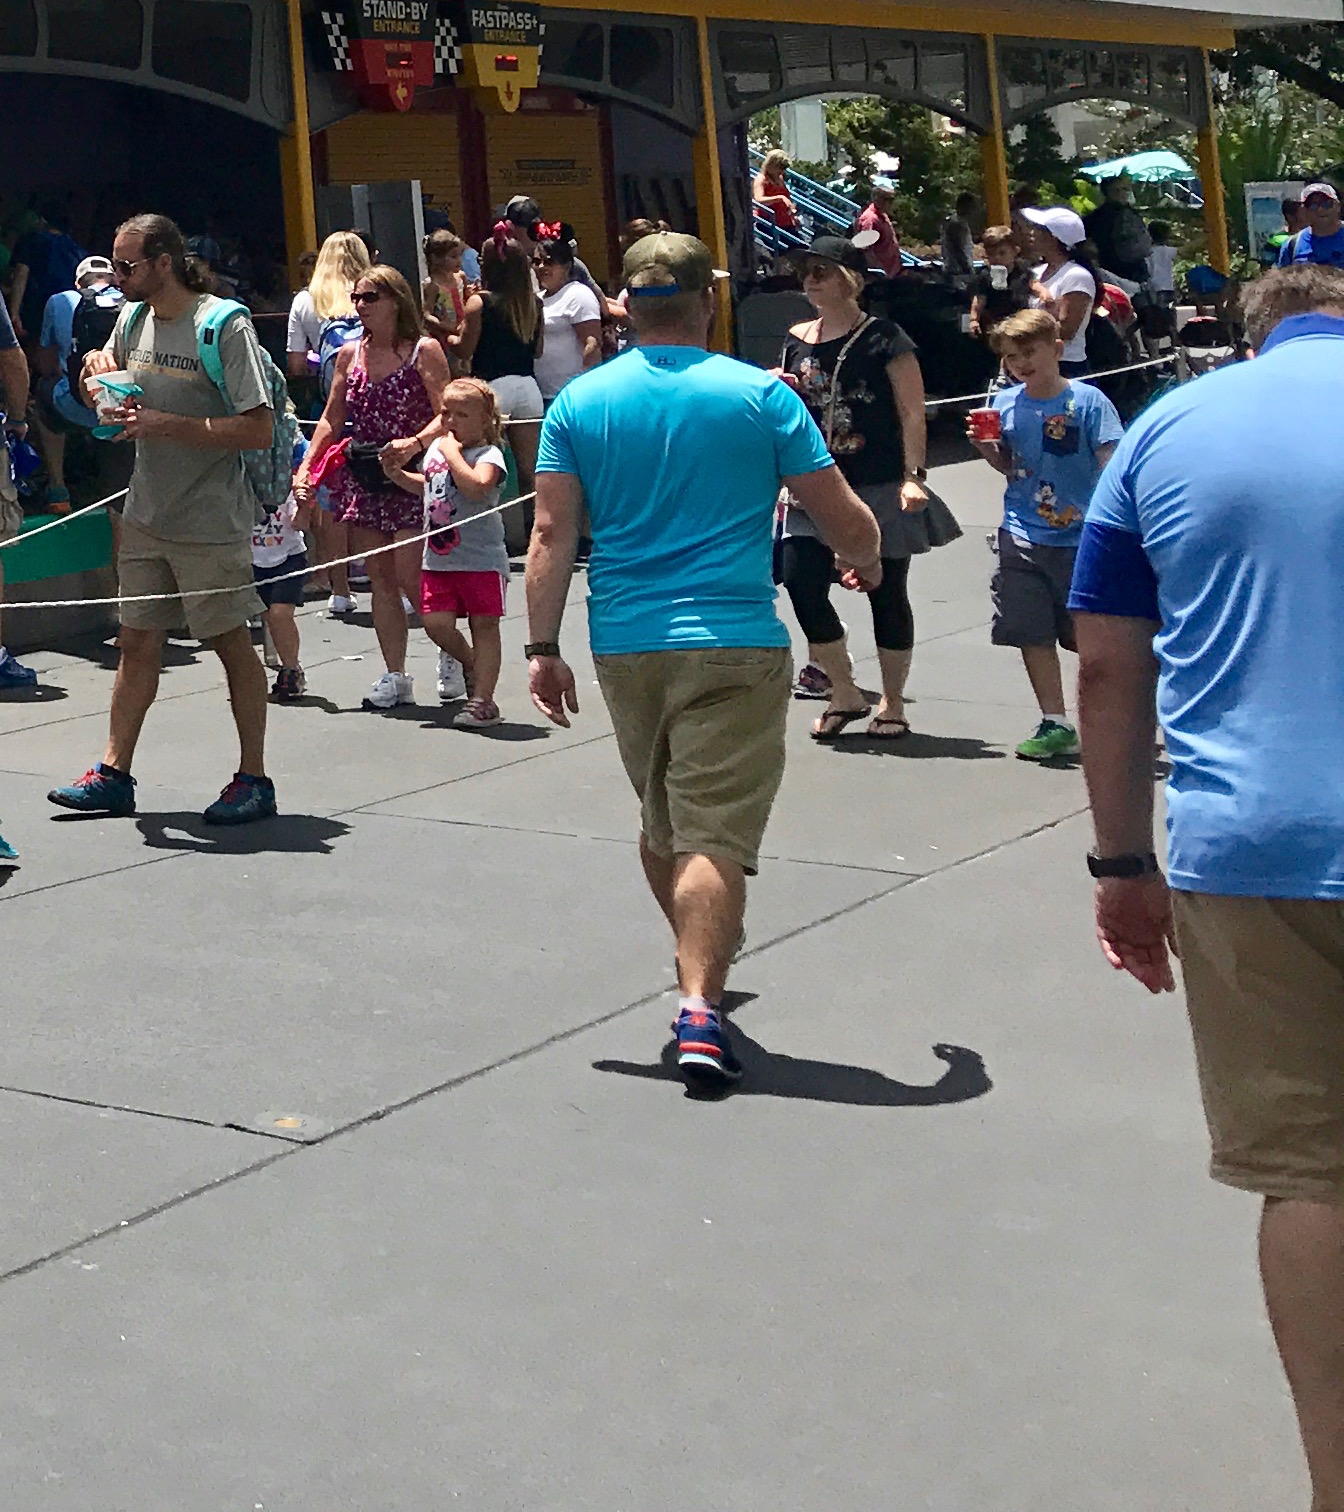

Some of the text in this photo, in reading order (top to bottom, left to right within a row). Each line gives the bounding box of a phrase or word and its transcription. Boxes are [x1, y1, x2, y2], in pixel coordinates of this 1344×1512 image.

[373, 19, 421, 34] ENTRANCE
[471, 9, 538, 29] FASTPASS+
[154, 351, 200, 371] NATION
